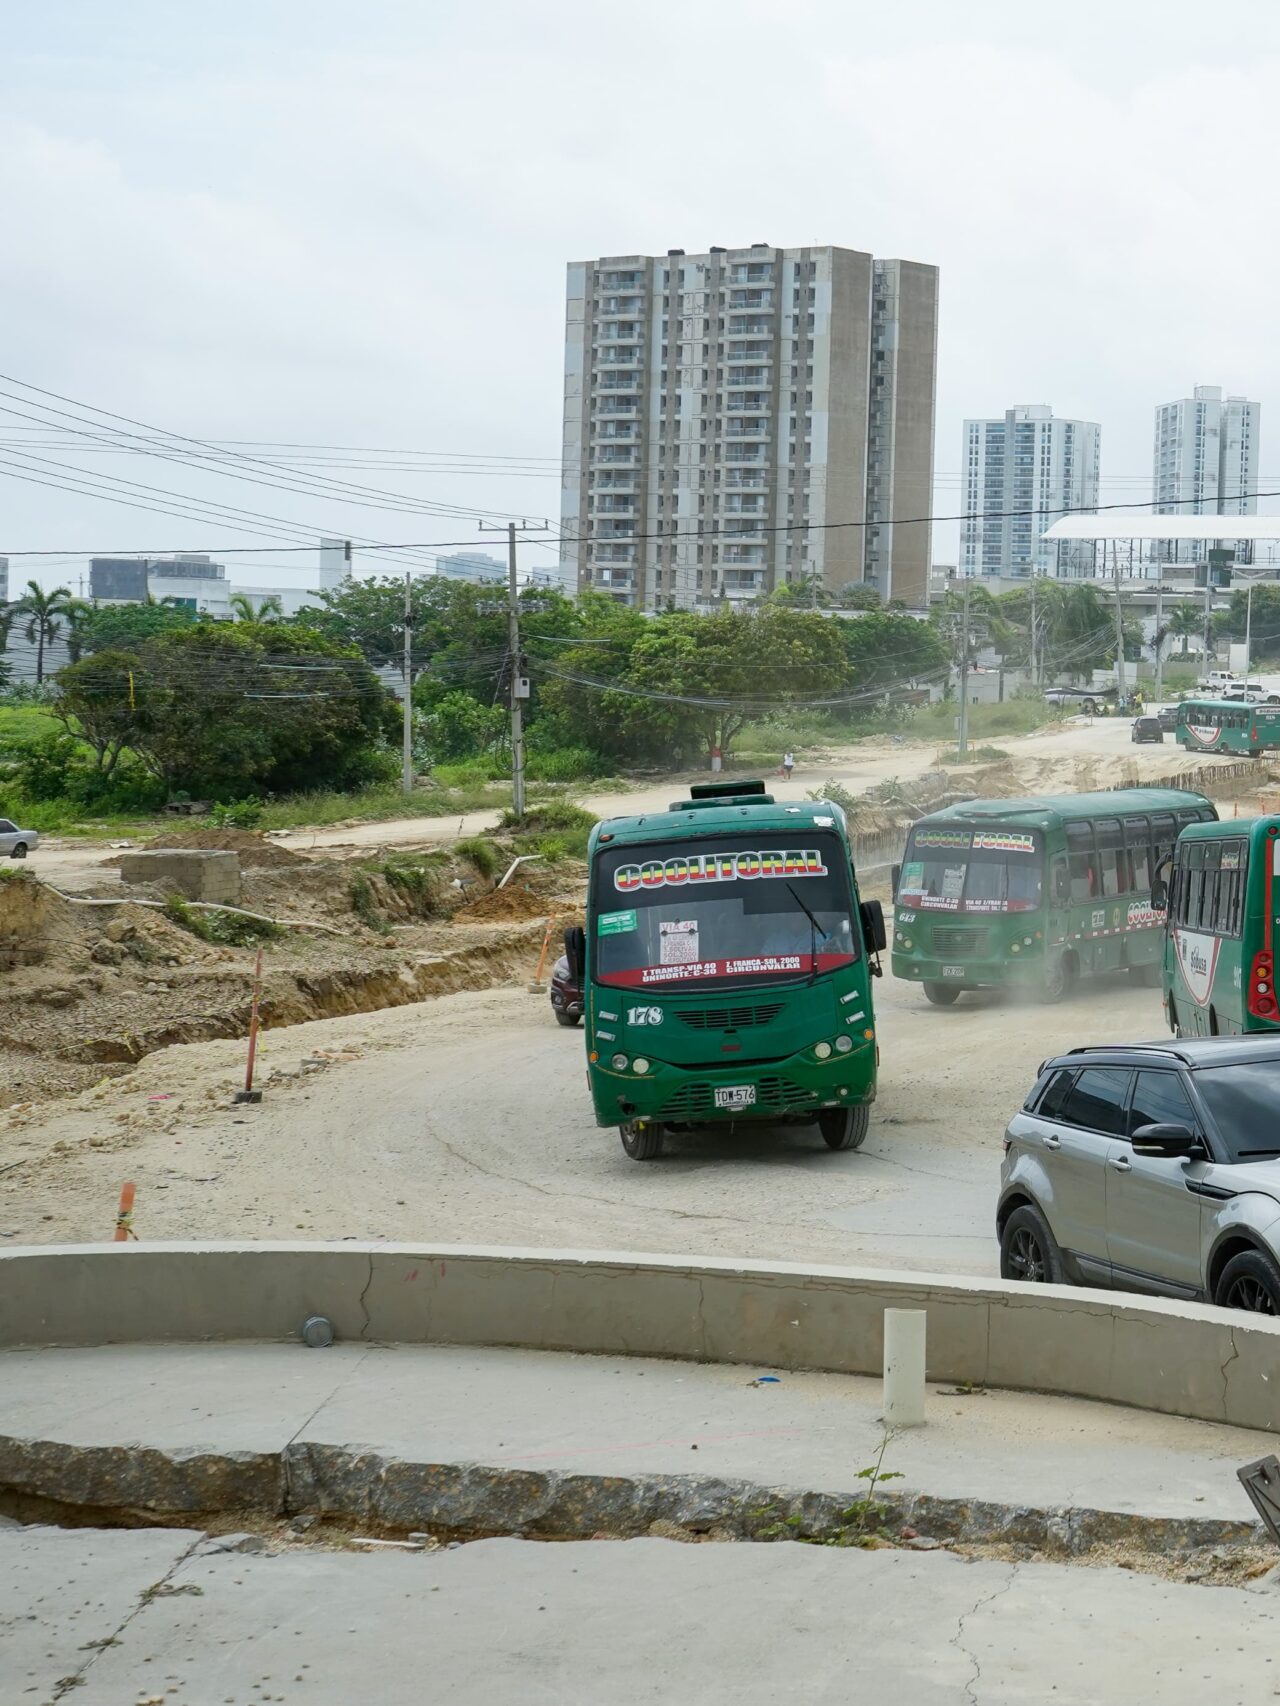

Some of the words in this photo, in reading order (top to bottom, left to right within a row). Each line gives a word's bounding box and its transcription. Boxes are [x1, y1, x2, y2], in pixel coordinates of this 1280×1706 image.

[614, 850, 829, 893] COOLITORAL
[662, 923, 680, 932] VIA
[683, 921, 696, 930] 40
[726, 963, 801, 974] CIRCUNVALAR
[626, 1006, 664, 1026] 178
[716, 1089, 755, 1102] TDW-576
